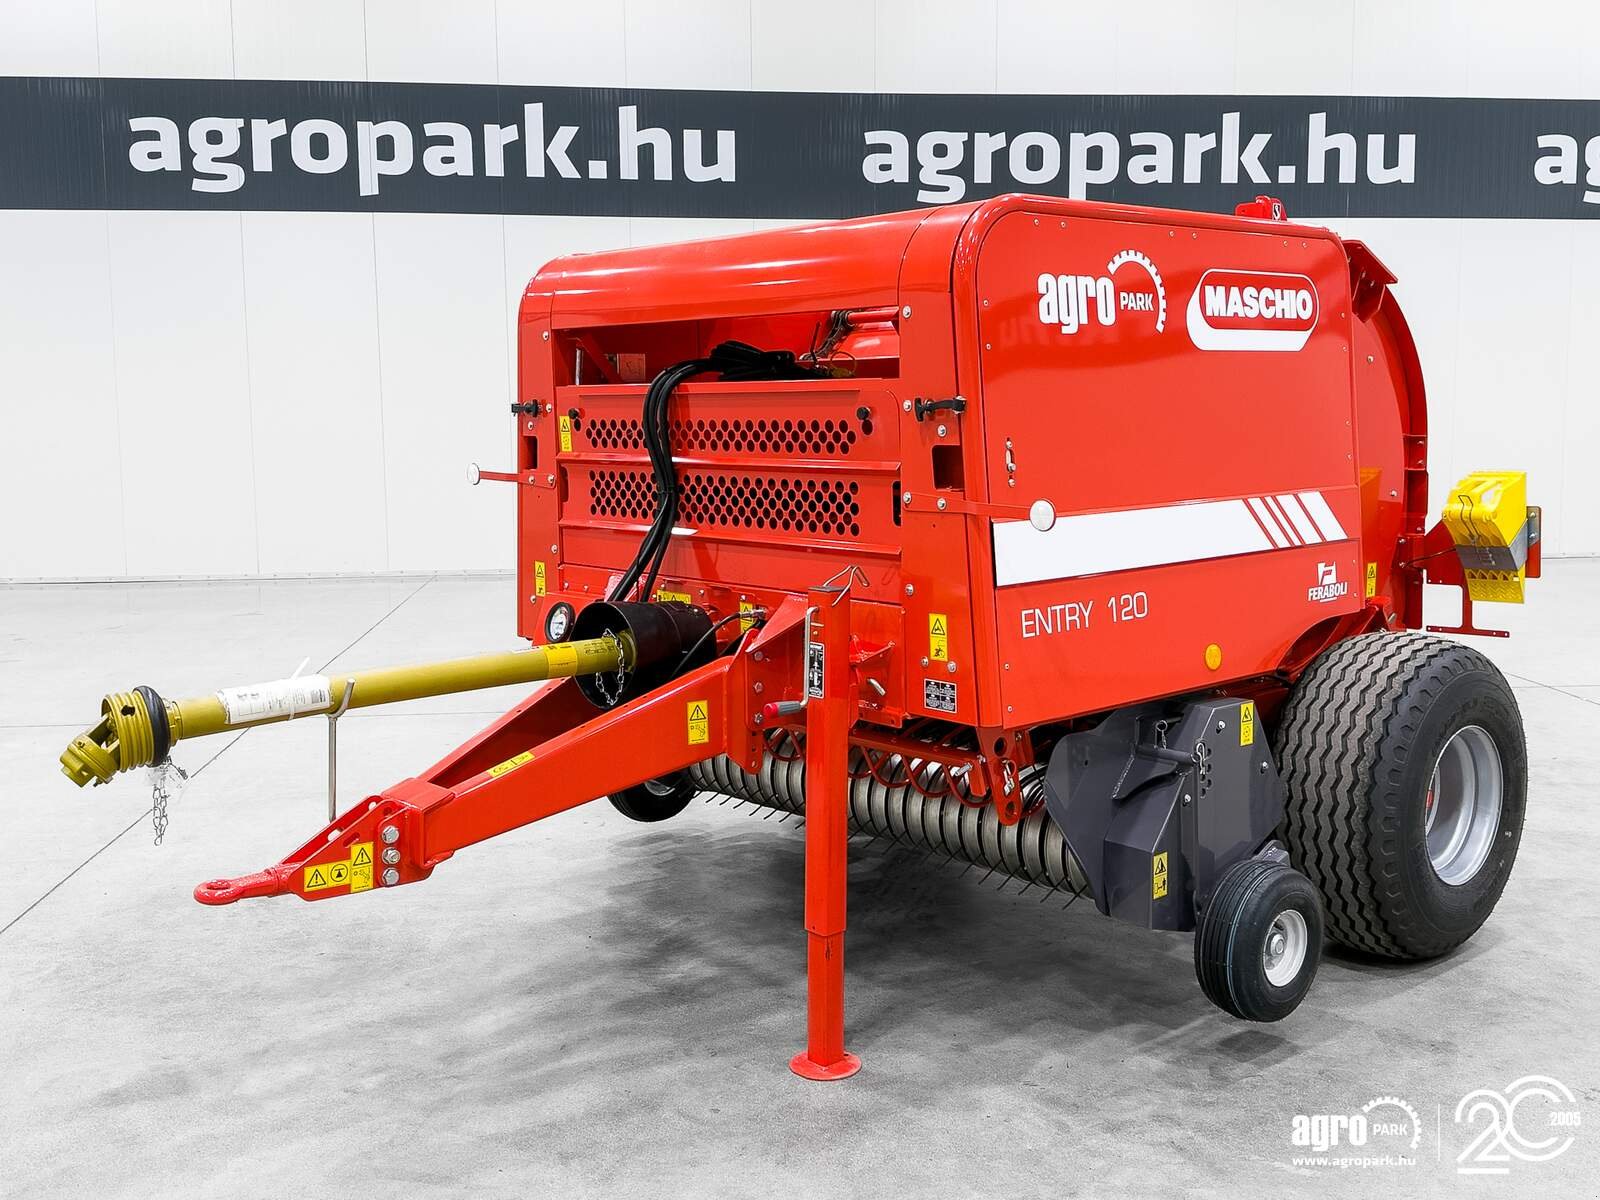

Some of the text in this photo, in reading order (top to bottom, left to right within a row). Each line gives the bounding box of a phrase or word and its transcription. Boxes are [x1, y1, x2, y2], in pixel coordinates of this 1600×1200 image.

[129, 102, 736, 196] agropark.hu
[862, 111, 1416, 202] agropark.hu
[1037, 273, 1154, 334] agro PARK
[1204, 285, 1313, 320] MASCHIO
[1021, 591, 1148, 638] ENTRY 120
[1308, 581, 1348, 602] FERABOLI
